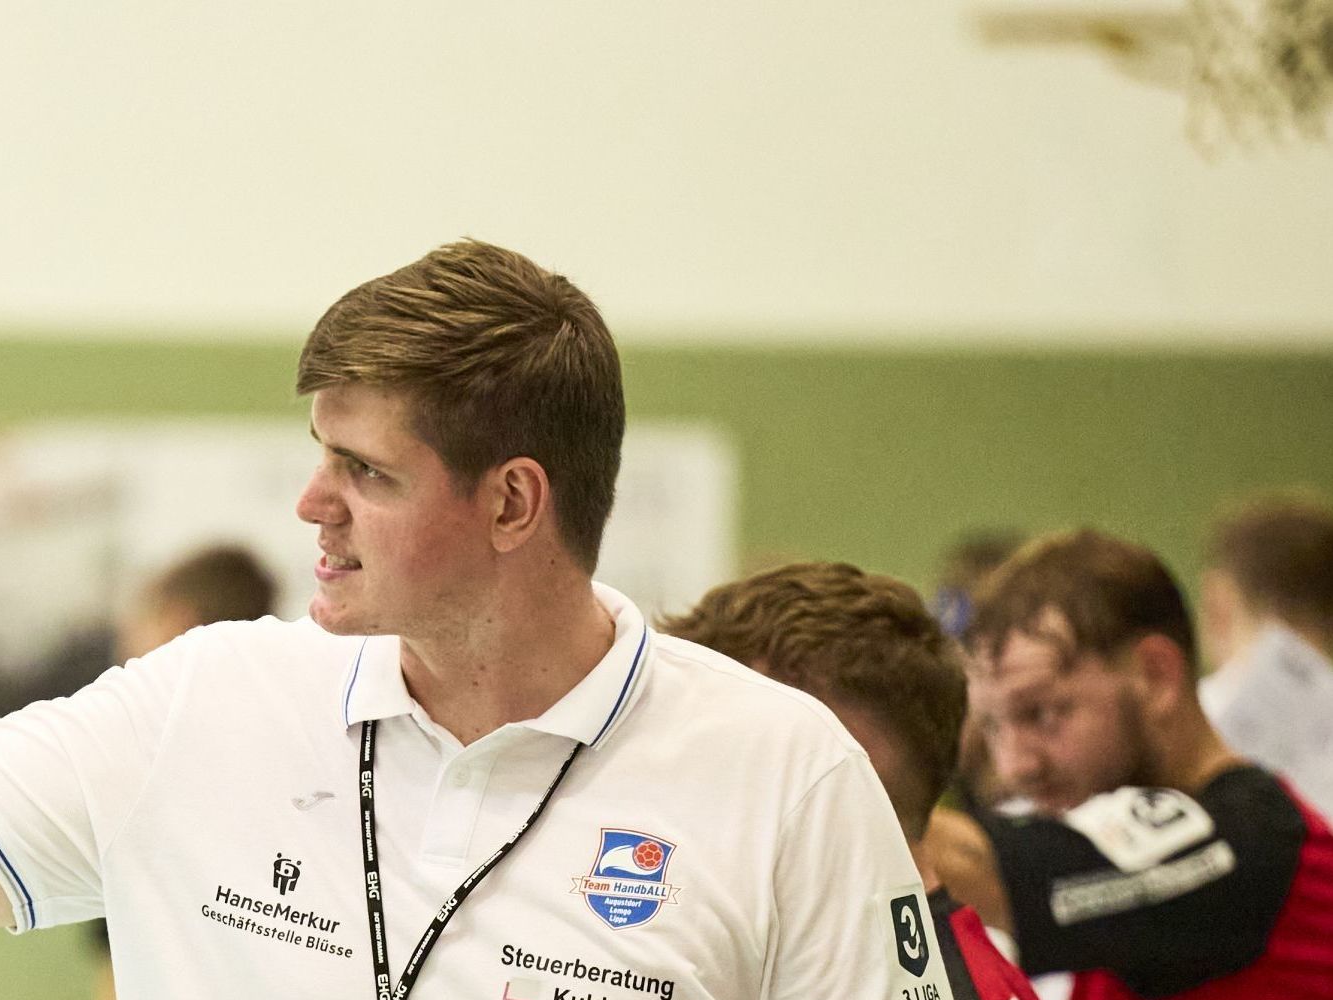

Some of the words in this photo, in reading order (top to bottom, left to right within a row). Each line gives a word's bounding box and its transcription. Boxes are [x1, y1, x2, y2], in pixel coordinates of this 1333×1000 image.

[584, 879, 610, 892] Team
[613, 882, 667, 897] HandbALL
[216, 885, 340, 934] HanseMerkur
[604, 897, 642, 908] Augustdorf
[609, 914, 628, 924] Lippe
[201, 904, 303, 945] Geschäftsstelle
[305, 935, 353, 958] Blüsse
